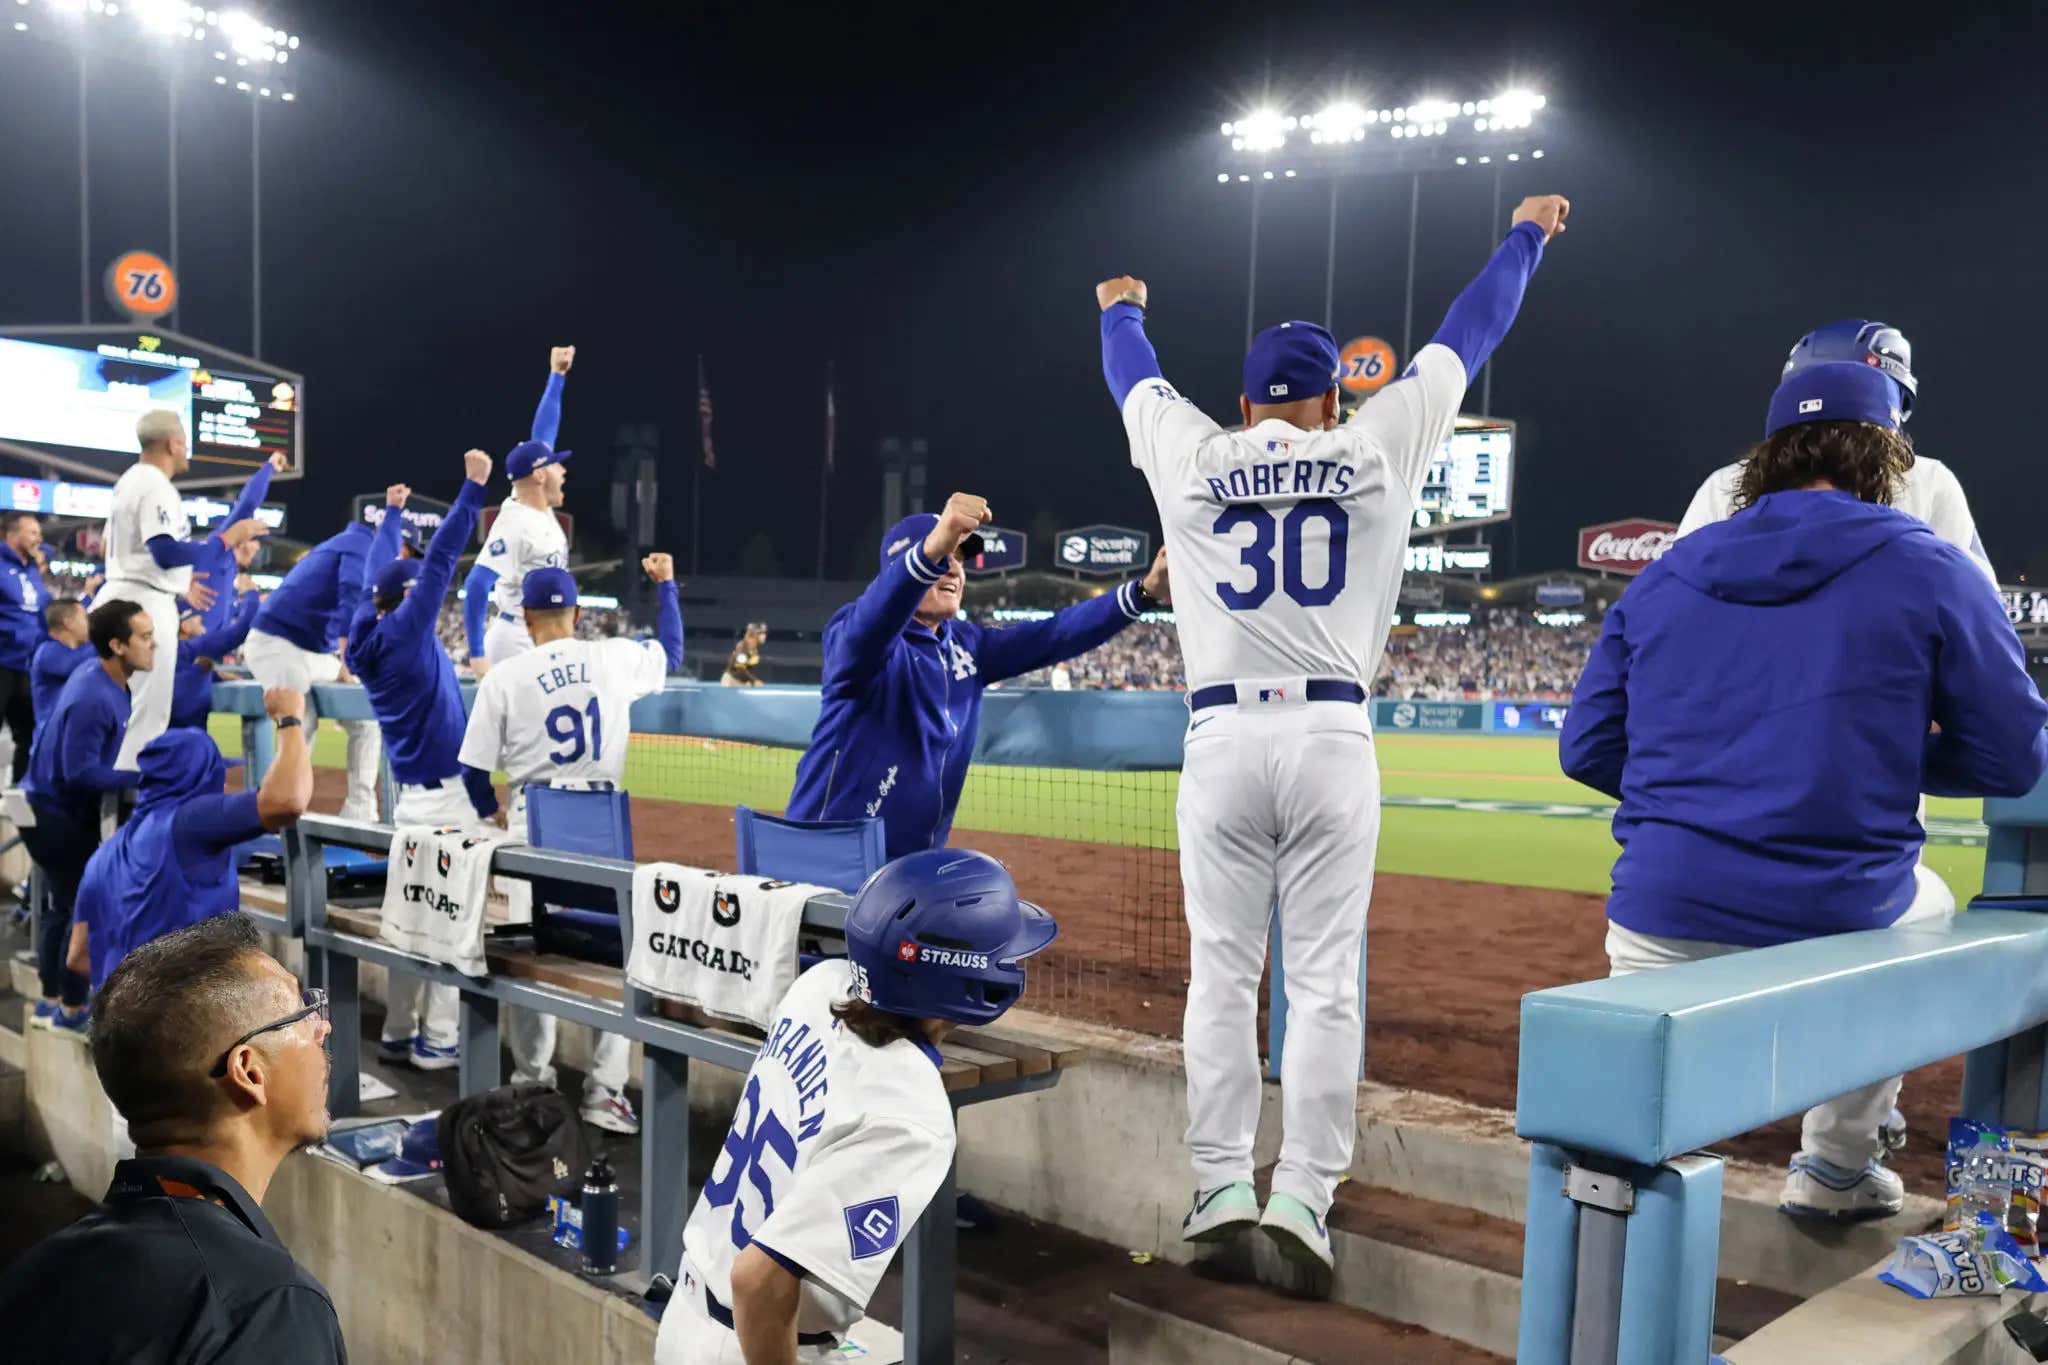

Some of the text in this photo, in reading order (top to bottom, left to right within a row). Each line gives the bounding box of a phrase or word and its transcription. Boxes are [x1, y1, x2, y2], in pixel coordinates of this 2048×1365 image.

[129, 272, 163, 299] 76
[1351, 354, 1382, 378] 76
[1206, 460, 1355, 501] ROBERTS
[364, 504, 444, 527] Sptrum
[1090, 537, 1140, 554] Security
[1091, 551, 1133, 563] Benefit
[1213, 498, 1349, 610] 30
[537, 663, 591, 694] EBEL
[544, 696, 602, 765] 91
[920, 948, 988, 970] STRAUSS
[863, 1208, 893, 1239] G
